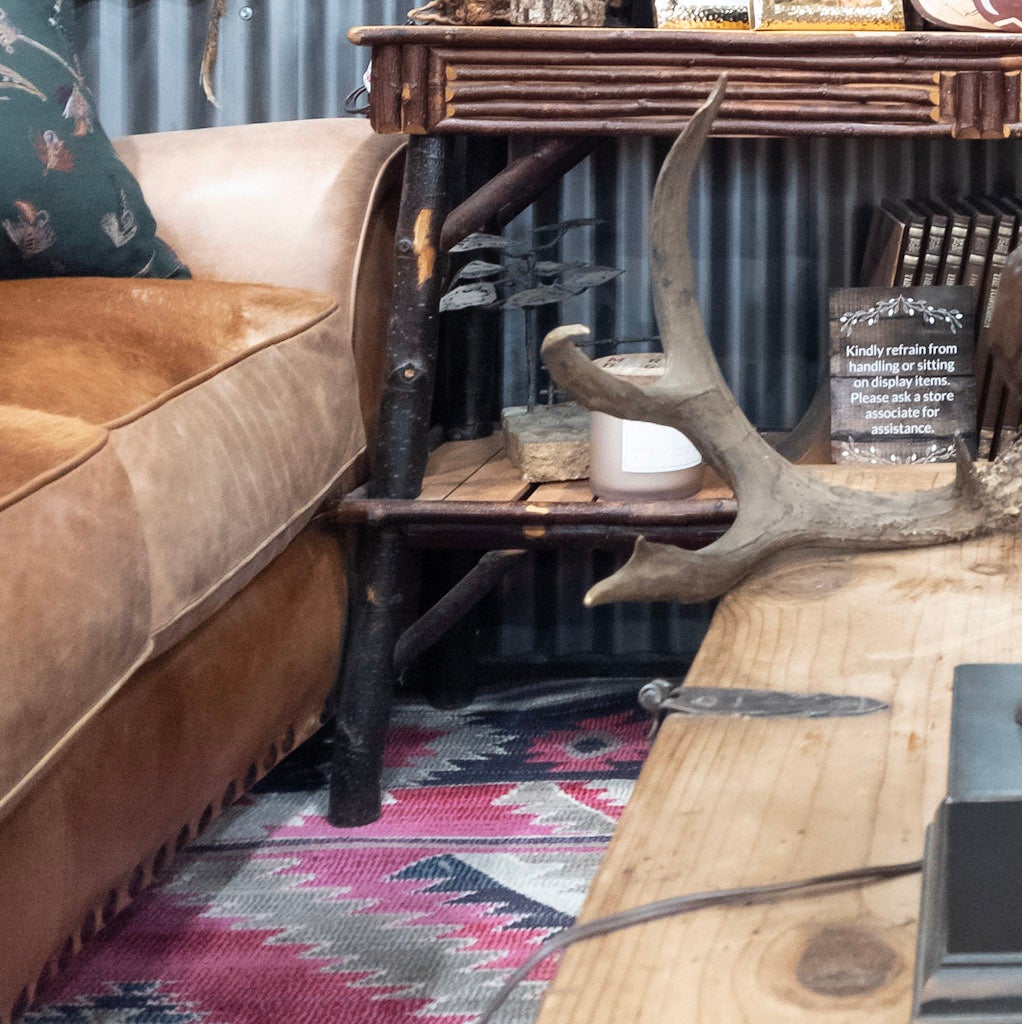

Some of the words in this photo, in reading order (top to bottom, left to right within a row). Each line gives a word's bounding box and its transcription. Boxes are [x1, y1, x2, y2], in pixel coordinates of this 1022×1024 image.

[992, 272, 1002, 287] THE
[846, 344, 884, 358] Kindly
[886, 343, 926, 356] refrain
[928, 343, 958, 354] from
[849, 360, 900, 374] handling
[901, 362, 915, 372] or
[917, 359, 955, 372] sitting
[853, 378, 868, 388] on
[871, 376, 913, 389] display
[915, 375, 951, 386] items.
[850, 392, 889, 404] Please
[891, 391, 912, 402] ask
[914, 393, 921, 402] a
[923, 391, 954, 402] store
[865, 407, 920, 419] associate
[922, 406, 940, 417] for
[871, 422, 935, 435] assistance.
